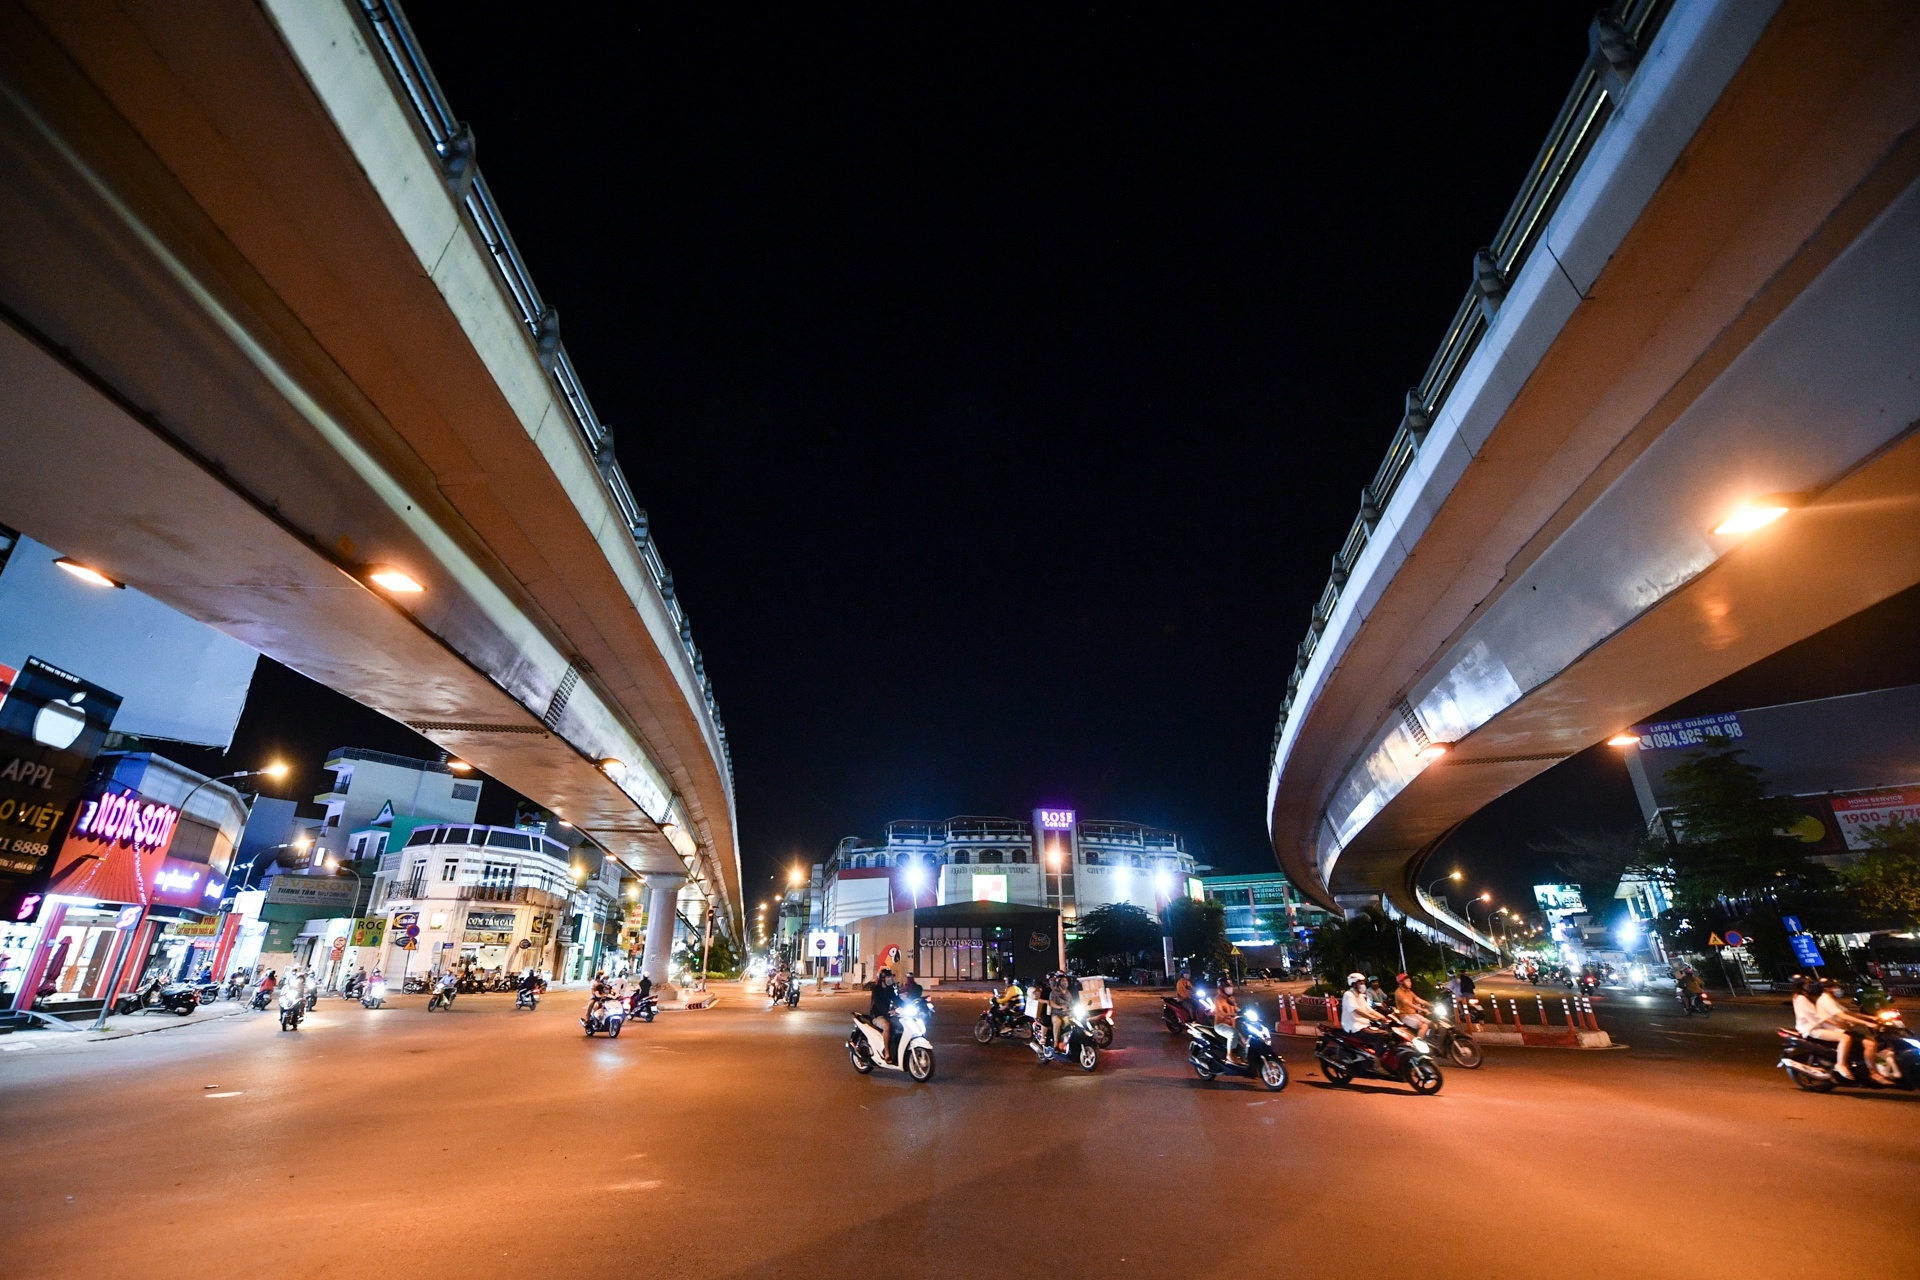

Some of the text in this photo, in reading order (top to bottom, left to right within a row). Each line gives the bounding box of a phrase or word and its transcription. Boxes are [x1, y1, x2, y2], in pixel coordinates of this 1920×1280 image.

[1650, 714, 1736, 733] LIÊN HỆ QUẢNG CÁO
[1, 758, 55, 790] APPL
[19, 802, 64, 832] VIỆT
[90, 789, 177, 847] NÓN SƠN
[1041, 811, 1073, 822] ROSE
[11, 840, 49, 857] 8888
[275, 877, 354, 892] EVERON
[277, 887, 300, 896] THANH
[358, 921, 383, 930] ROC
[468, 917, 484, 926] CƠM
[485, 915, 500, 926] TẤM
[944, 937, 984, 947] Amazon
